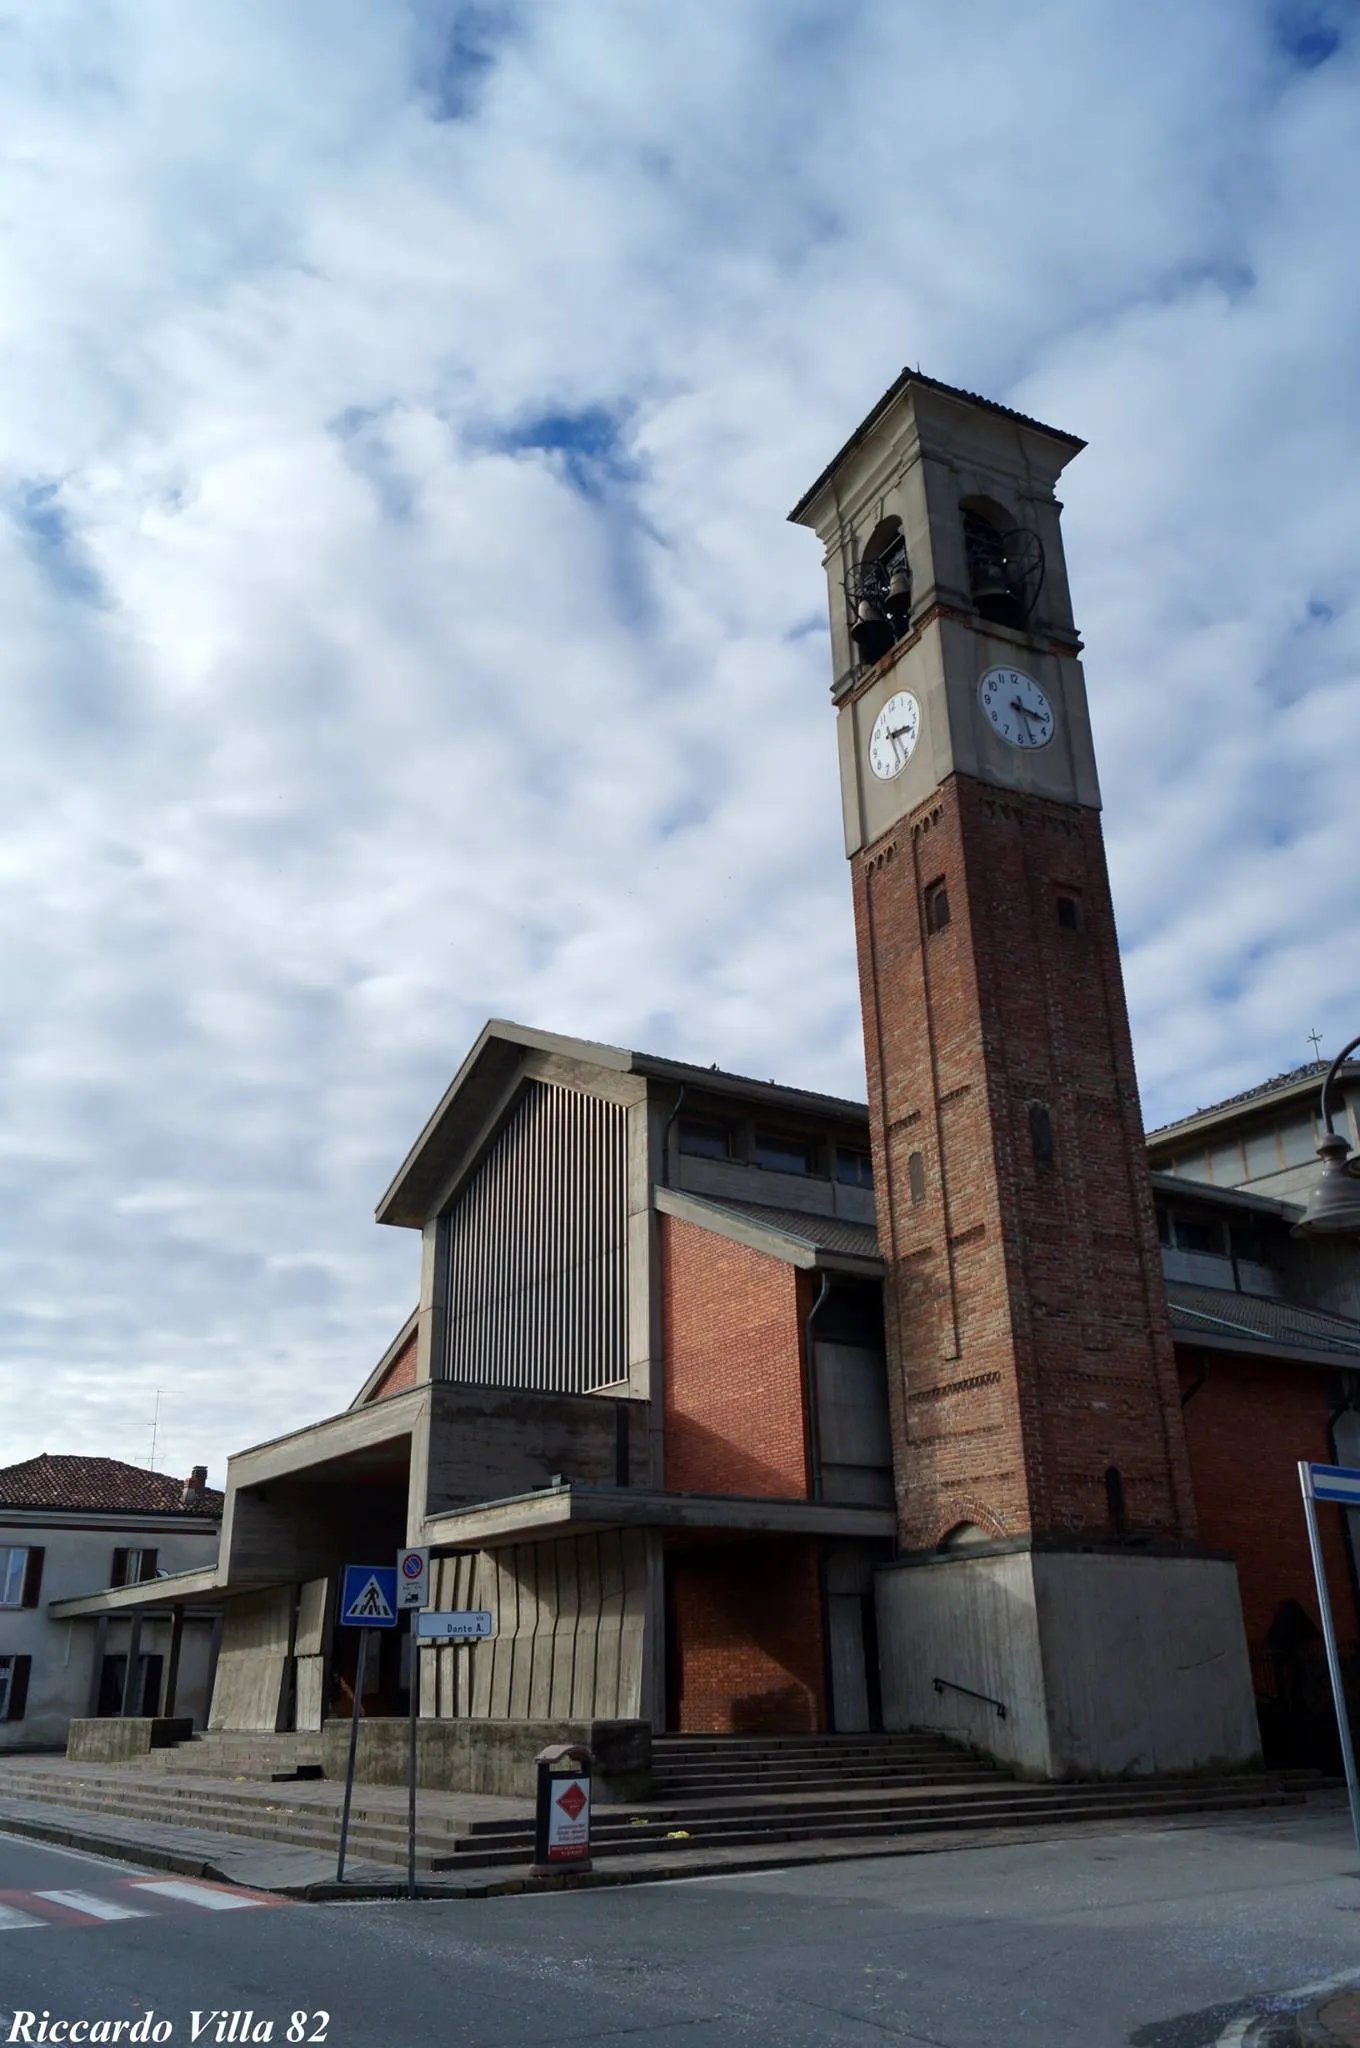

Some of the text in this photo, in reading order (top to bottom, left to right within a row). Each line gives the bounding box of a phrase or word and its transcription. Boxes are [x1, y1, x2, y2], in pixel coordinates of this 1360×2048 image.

[998, 673, 1005, 684] 11
[1010, 674, 1020, 685] 12
[988, 680, 998, 692] 10
[1027, 682, 1031, 692] 1
[984, 694, 992, 705] 9
[1037, 694, 1044, 706] 2
[992, 711, 998, 722] 8
[1043, 712, 1050, 723] 3
[1003, 723, 1010, 735] 7
[1040, 727, 1047, 736] 4
[1017, 734, 1024, 745] 6
[1029, 734, 1037, 745] 5
[447, 1623, 485, 1633] Dante A.
